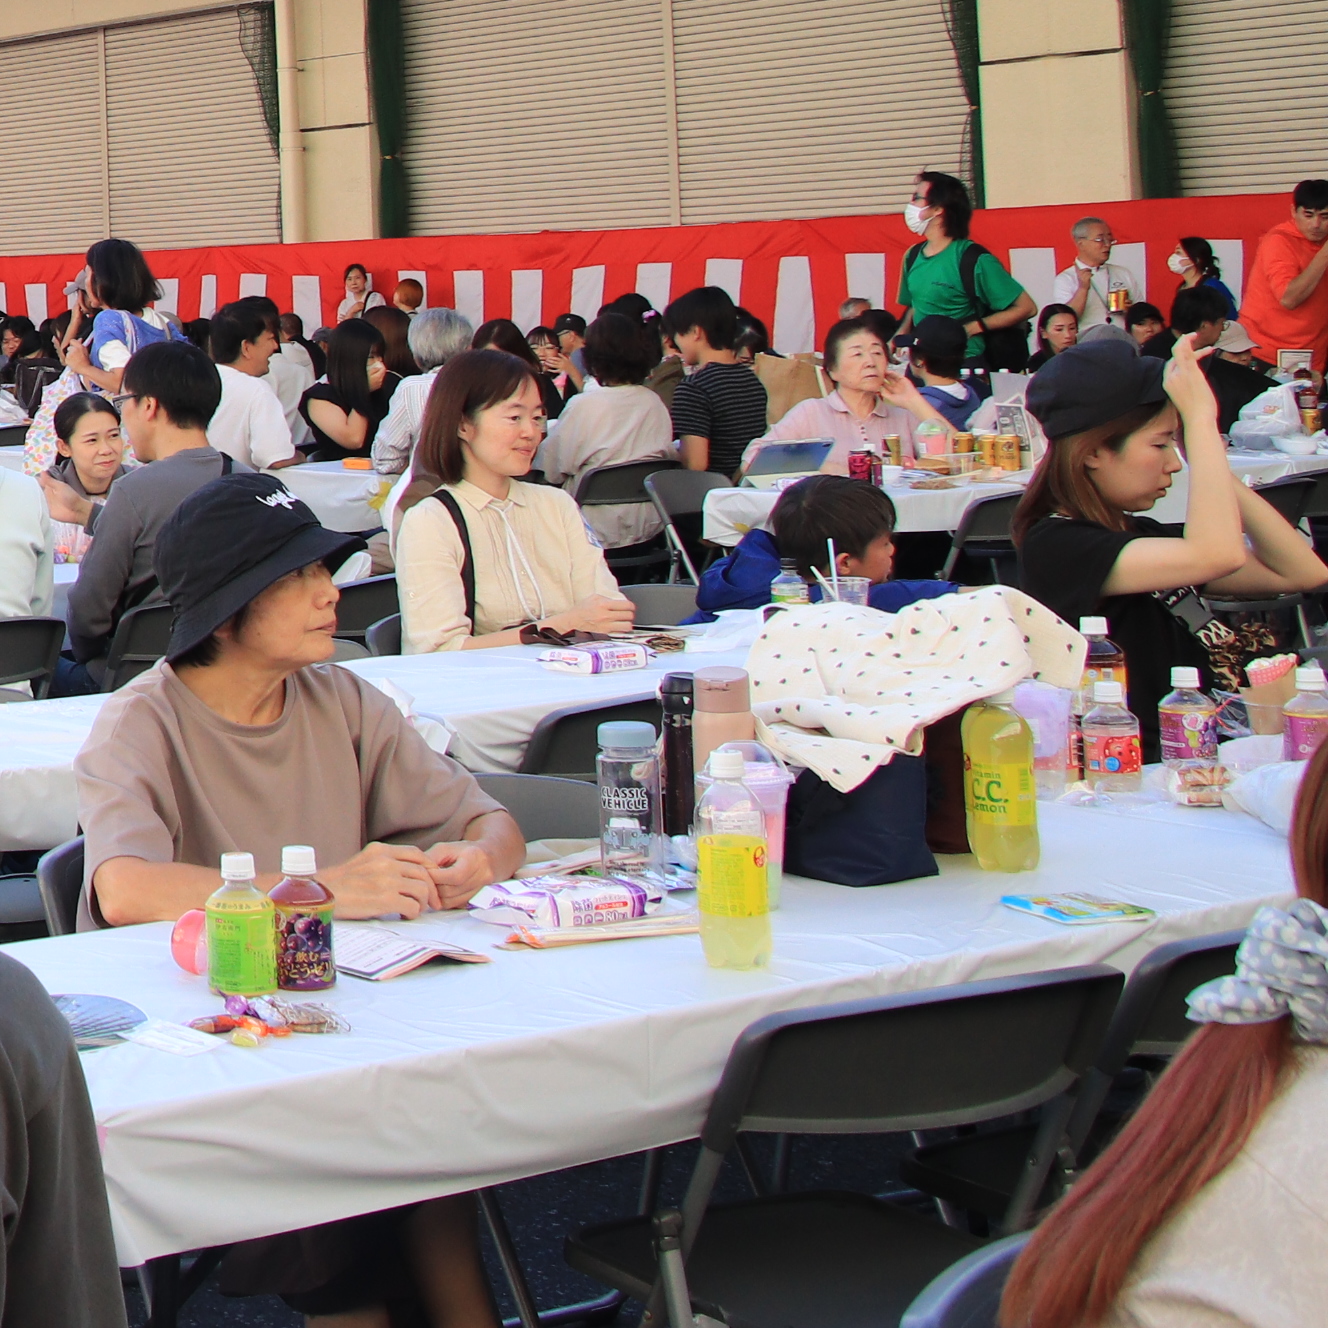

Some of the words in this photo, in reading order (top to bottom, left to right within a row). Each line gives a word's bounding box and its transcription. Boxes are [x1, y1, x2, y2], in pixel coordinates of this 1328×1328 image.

[601, 786, 647, 799] CLASSIC
[601, 798, 649, 810] VEHICLE
[295, 951, 320, 963] 飲む
